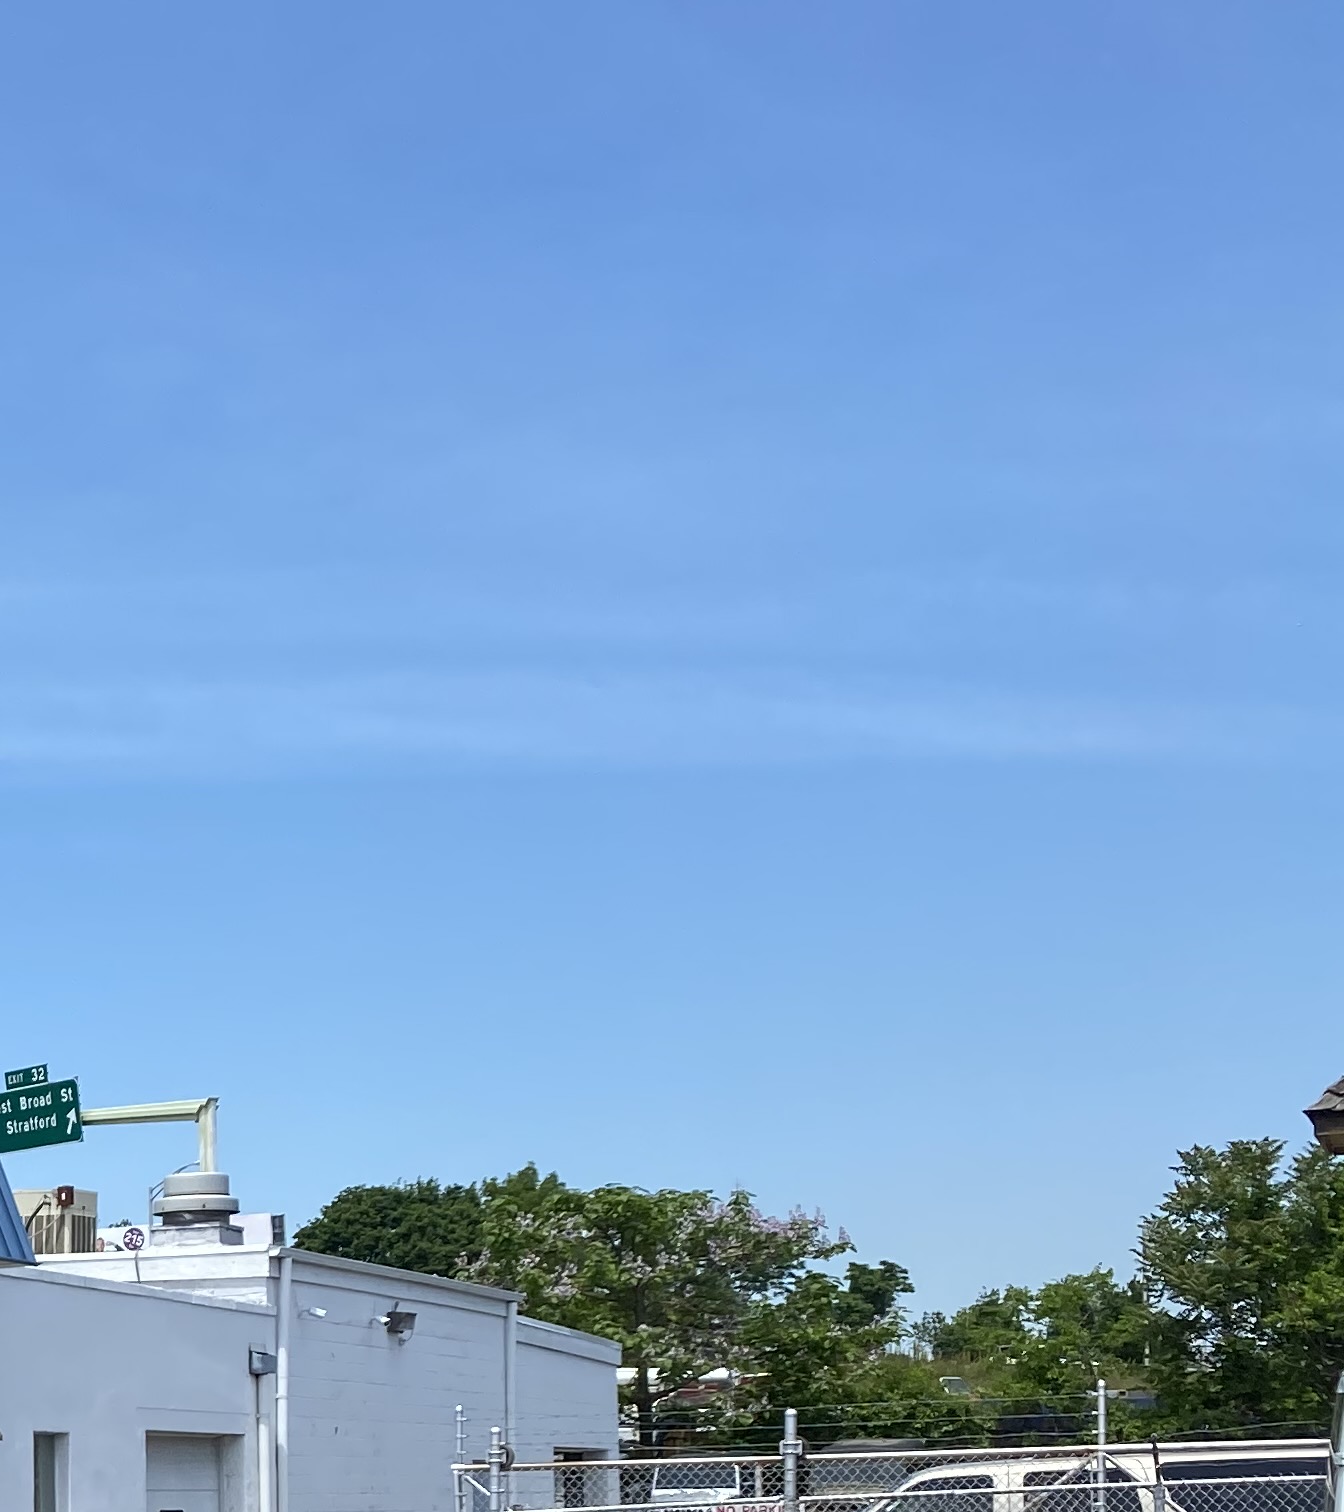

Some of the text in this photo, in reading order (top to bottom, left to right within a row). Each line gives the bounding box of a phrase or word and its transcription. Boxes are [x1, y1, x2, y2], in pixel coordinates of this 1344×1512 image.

[7, 1067, 46, 1085] EXIT 32
[19, 1091, 52, 1110] Broad
[60, 1086, 74, 1103] St
[6, 1112, 57, 1135] Stratford
[123, 1232, 144, 1247] 215
